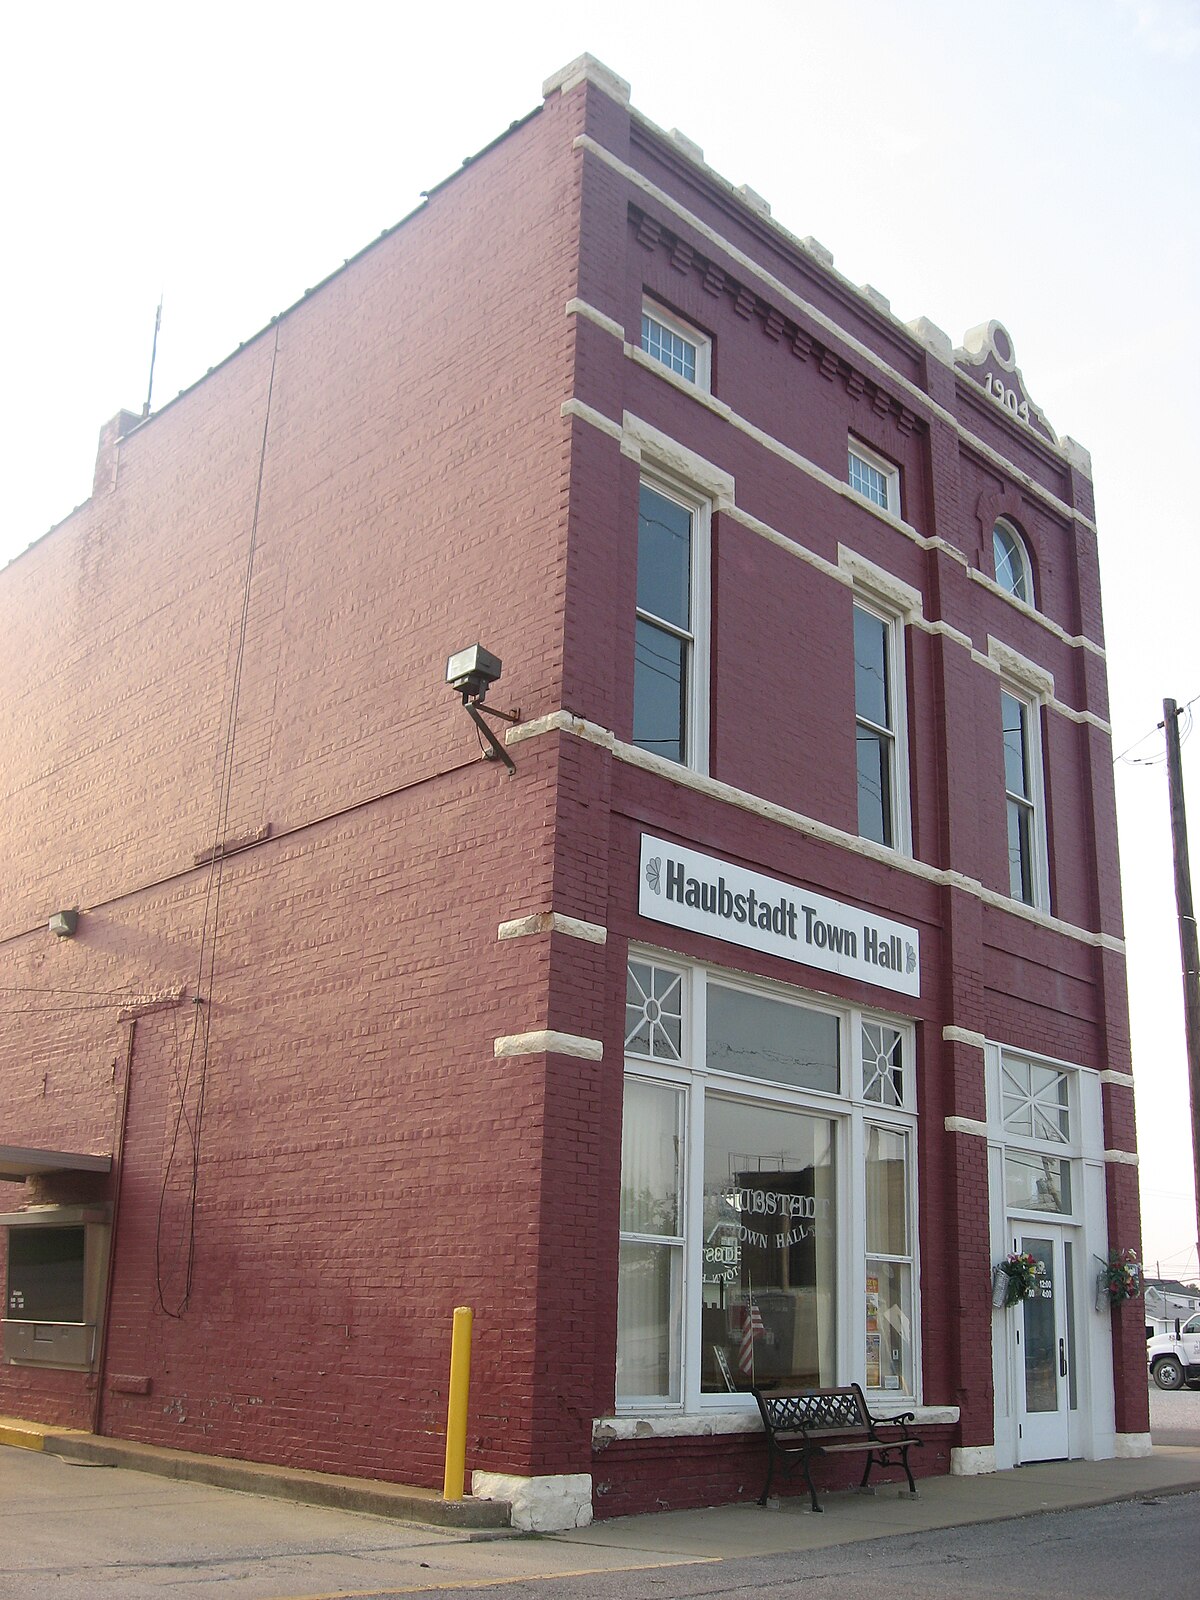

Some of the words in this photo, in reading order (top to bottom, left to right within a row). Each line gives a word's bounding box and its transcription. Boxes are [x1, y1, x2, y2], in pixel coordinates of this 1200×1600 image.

[985, 372, 1029, 425] 1904
[666, 859, 797, 940] Haubstadt
[801, 905, 857, 959] Town
[863, 926, 903, 973] Hall
[738, 1225, 768, 1249] OWN
[775, 1224, 808, 1249] HALL
